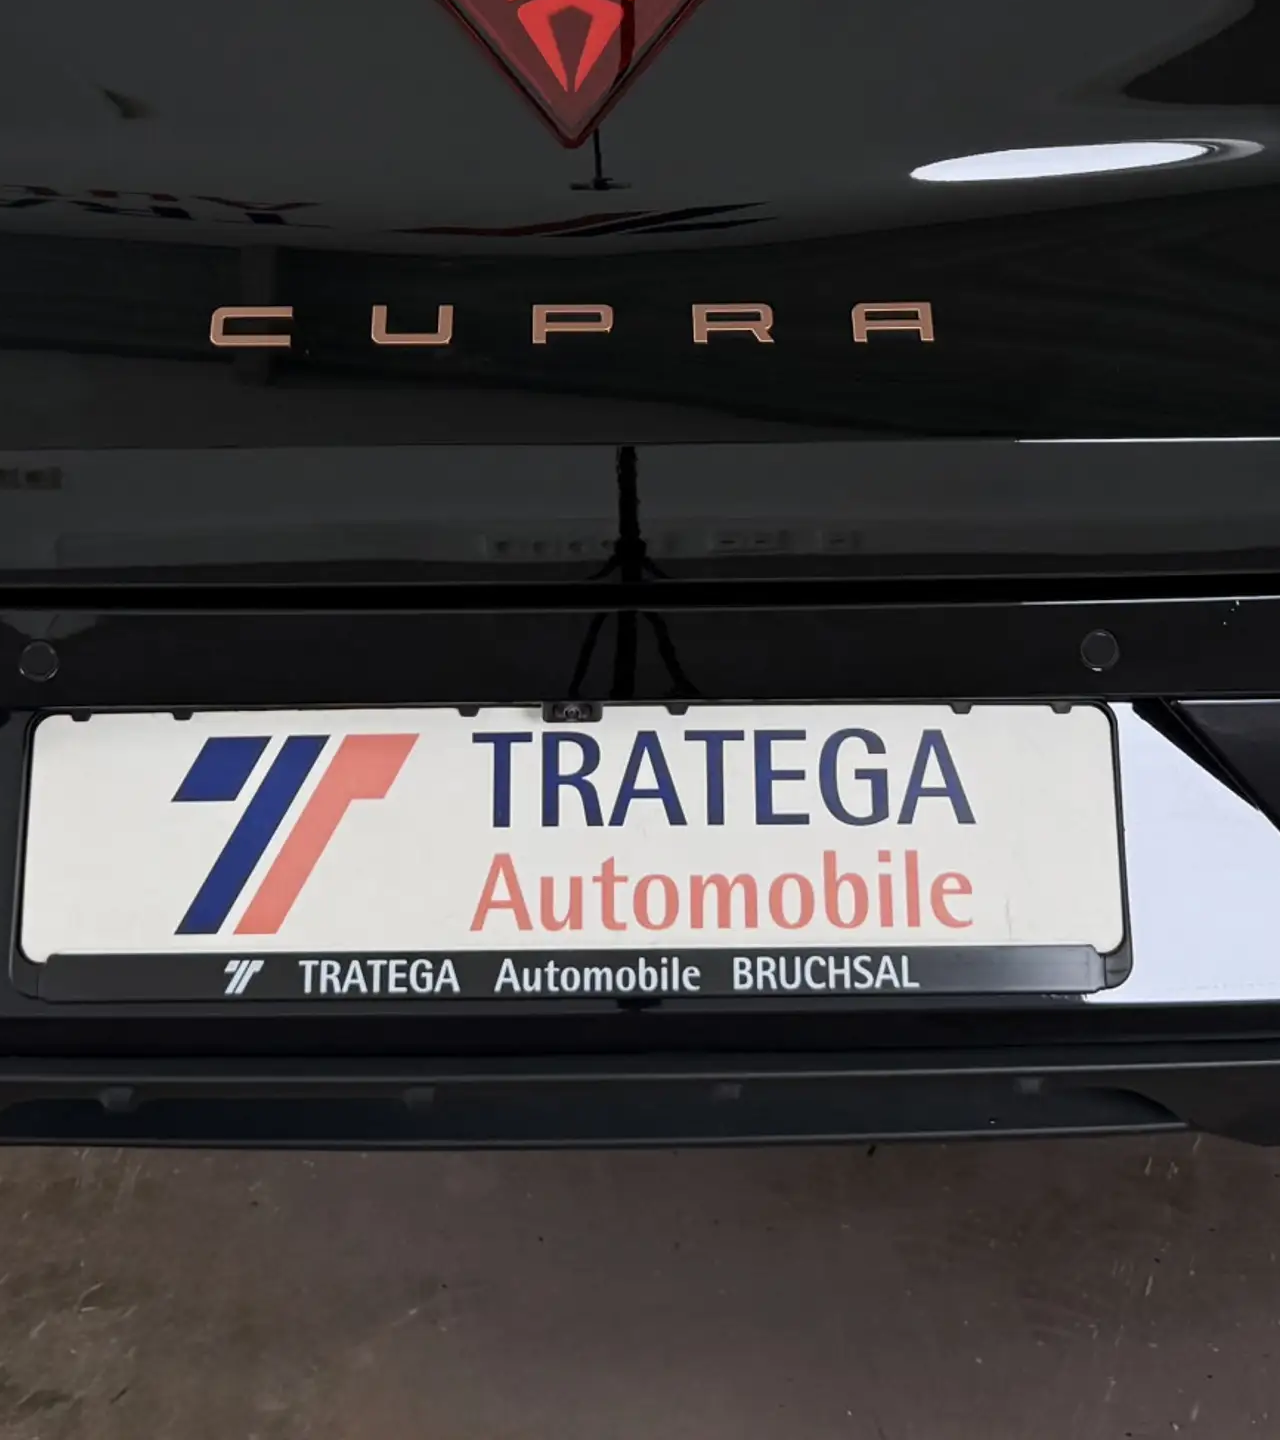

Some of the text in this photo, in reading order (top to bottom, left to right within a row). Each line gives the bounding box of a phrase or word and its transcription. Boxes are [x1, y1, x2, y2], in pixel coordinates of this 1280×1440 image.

[210, 301, 935, 348] CUPRA
[471, 727, 976, 827] TRATEGA
[469, 849, 973, 932] Automobile
[298, 954, 921, 994] TRATEGA Automobile BRUCHSAL
